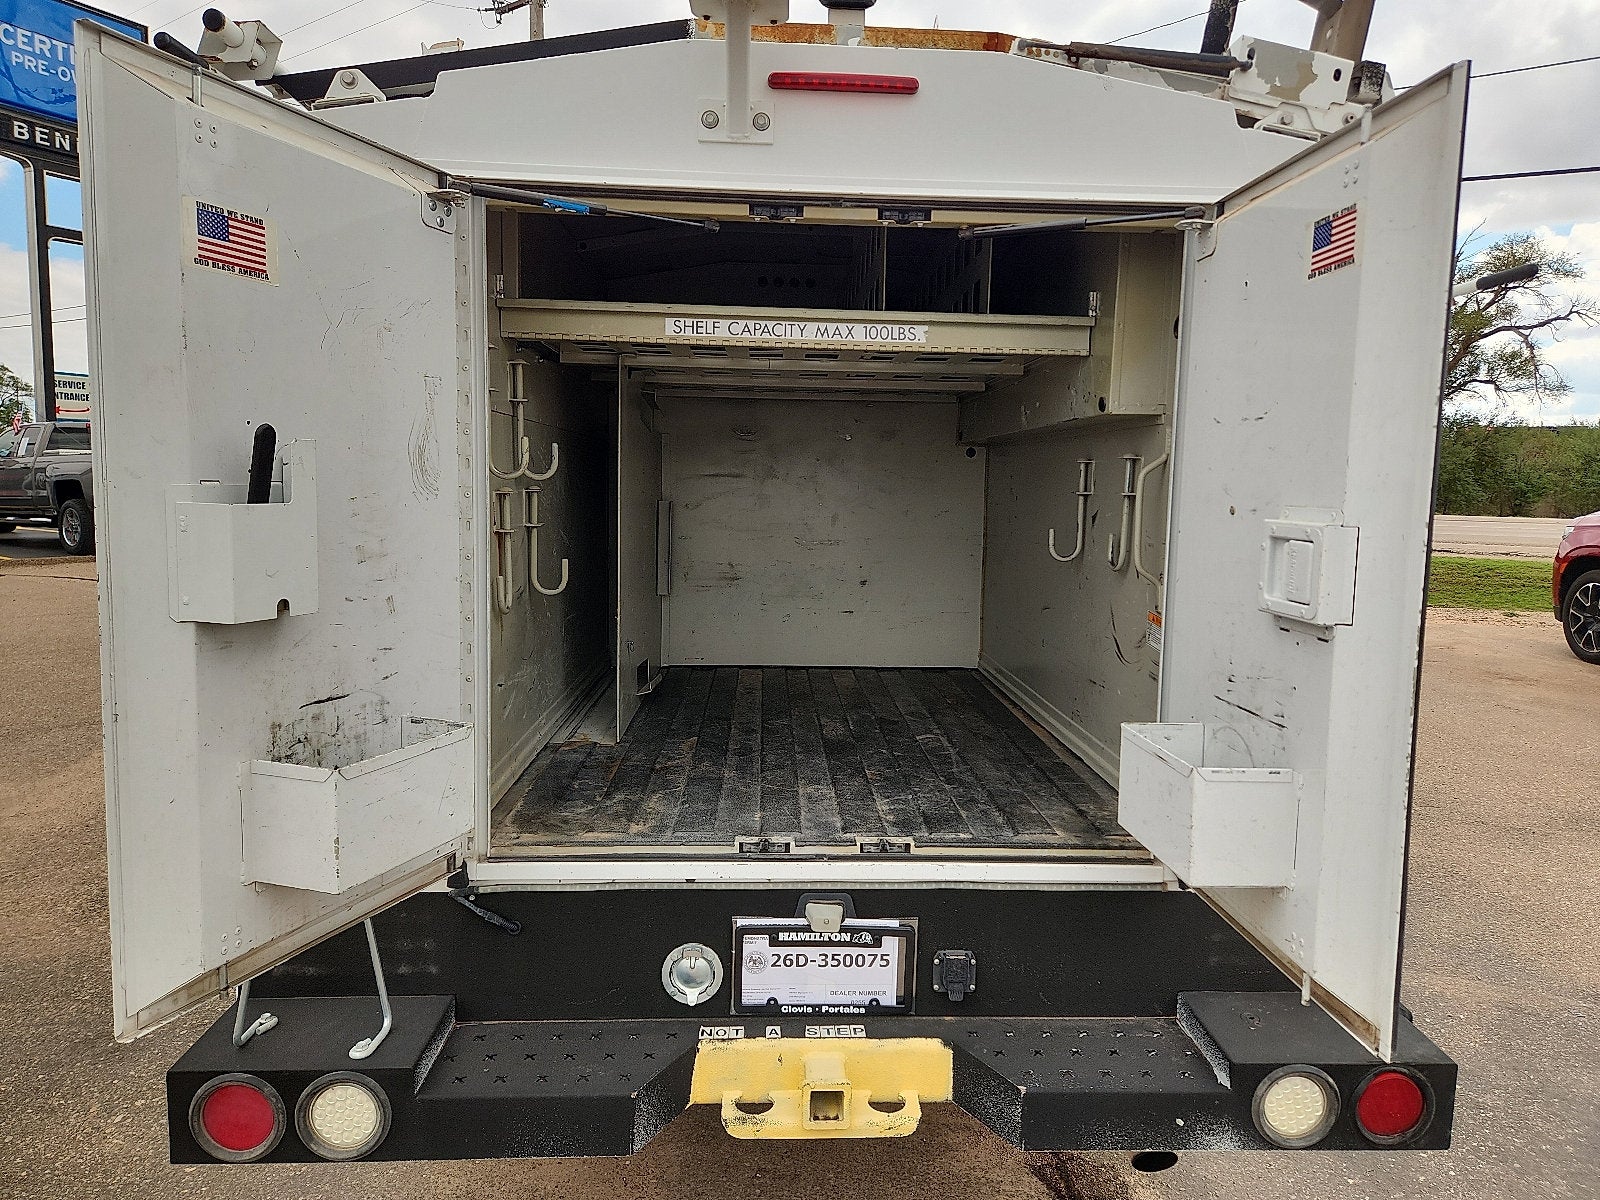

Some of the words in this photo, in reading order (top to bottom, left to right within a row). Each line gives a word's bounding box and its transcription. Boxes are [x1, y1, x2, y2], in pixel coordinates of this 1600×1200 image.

[11, 50, 77, 84] PRE-O
[13, 120, 79, 154] BEN
[196, 201, 224, 214] UNITED
[227, 210, 238, 218] WE
[240, 213, 263, 225] STAND
[194, 258, 209, 266] GOD
[212, 262, 235, 272] BLESS
[238, 268, 269, 280] AMERICA
[672, 319, 721, 336] SHELF
[727, 321, 808, 339] CAPACITY
[814, 324, 856, 340] MAX
[862, 325, 922, 342] 100LBS.
[778, 931, 851, 942] HAMILTON
[770, 952, 891, 968] 26D-350075
[781, 1005, 813, 1013] Clovis
[821, 1005, 866, 1014] Portales
[700, 1028, 743, 1037] NOT
[768, 1028, 780, 1036] A
[806, 1026, 865, 1036] STEP
